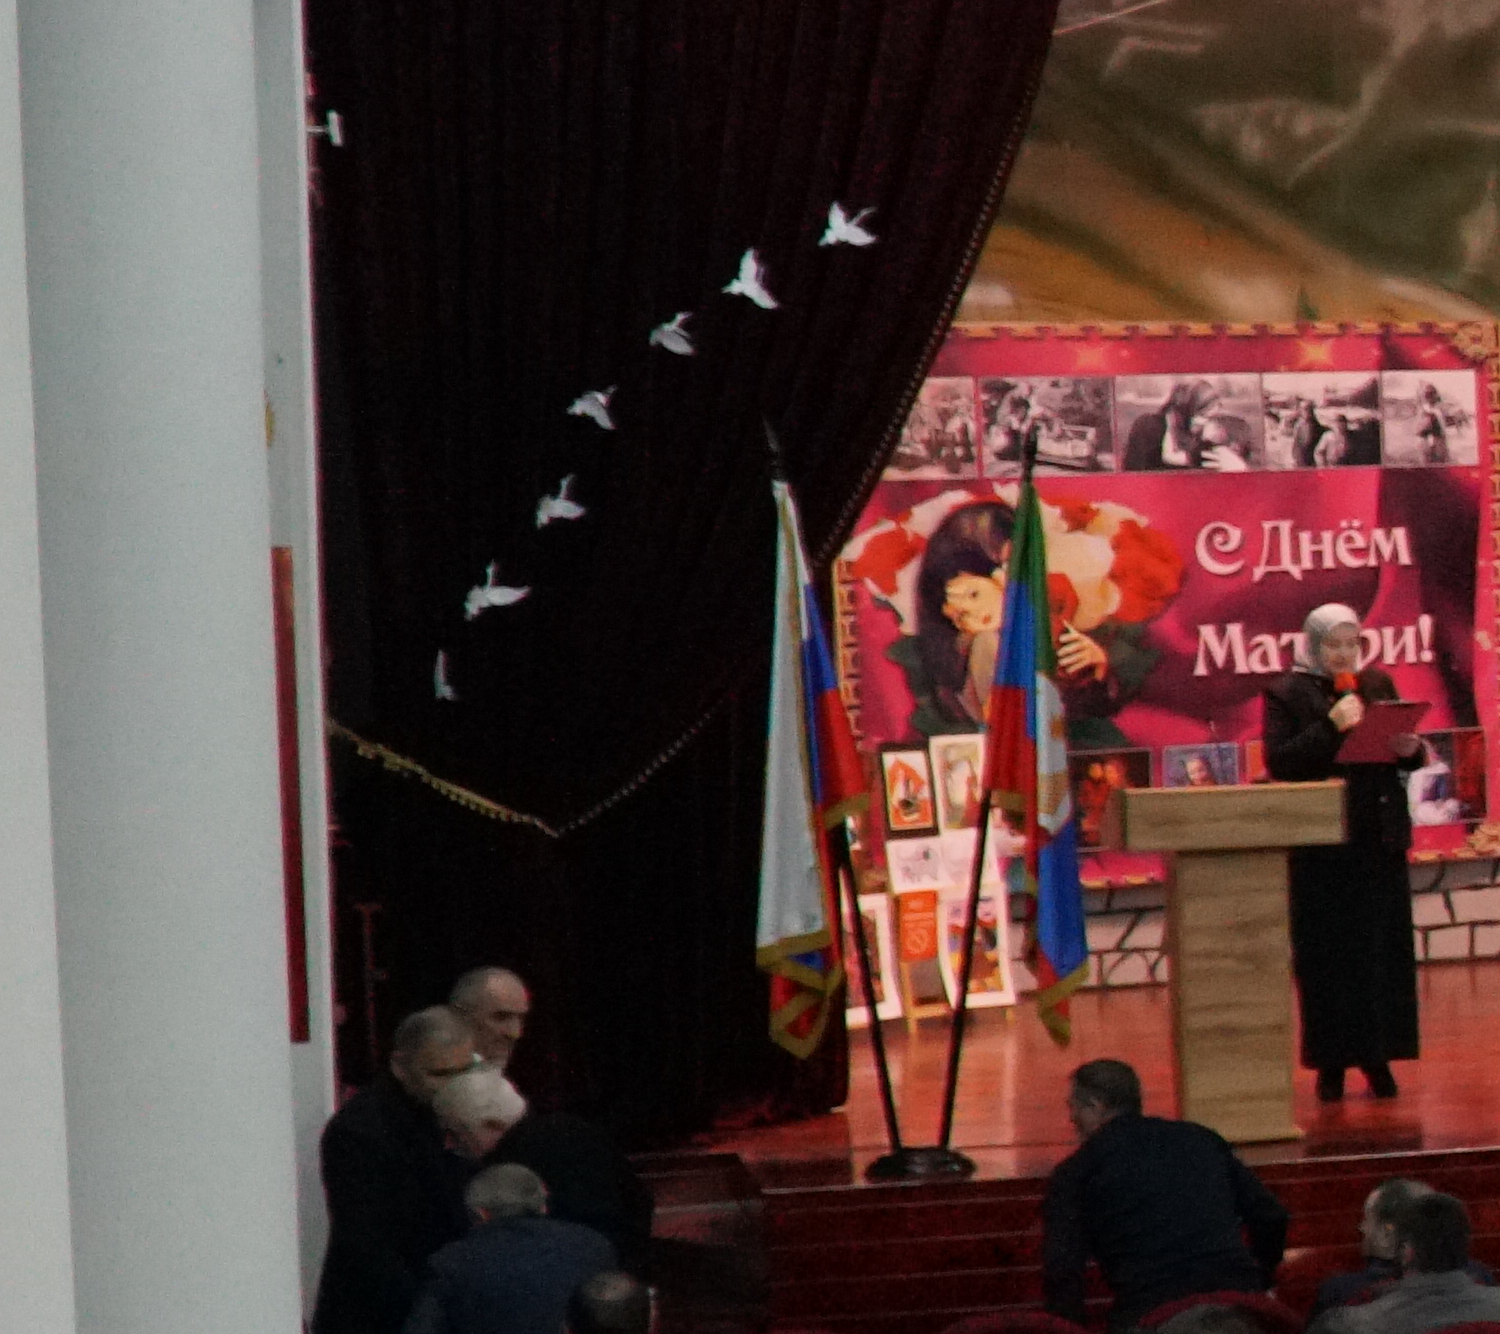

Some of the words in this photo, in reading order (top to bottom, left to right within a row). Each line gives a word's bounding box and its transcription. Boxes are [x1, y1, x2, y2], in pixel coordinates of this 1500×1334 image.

[1195, 520, 1246, 576] С
[1251, 518, 1413, 583] Днём
[1193, 613, 1434, 677] Матри!
